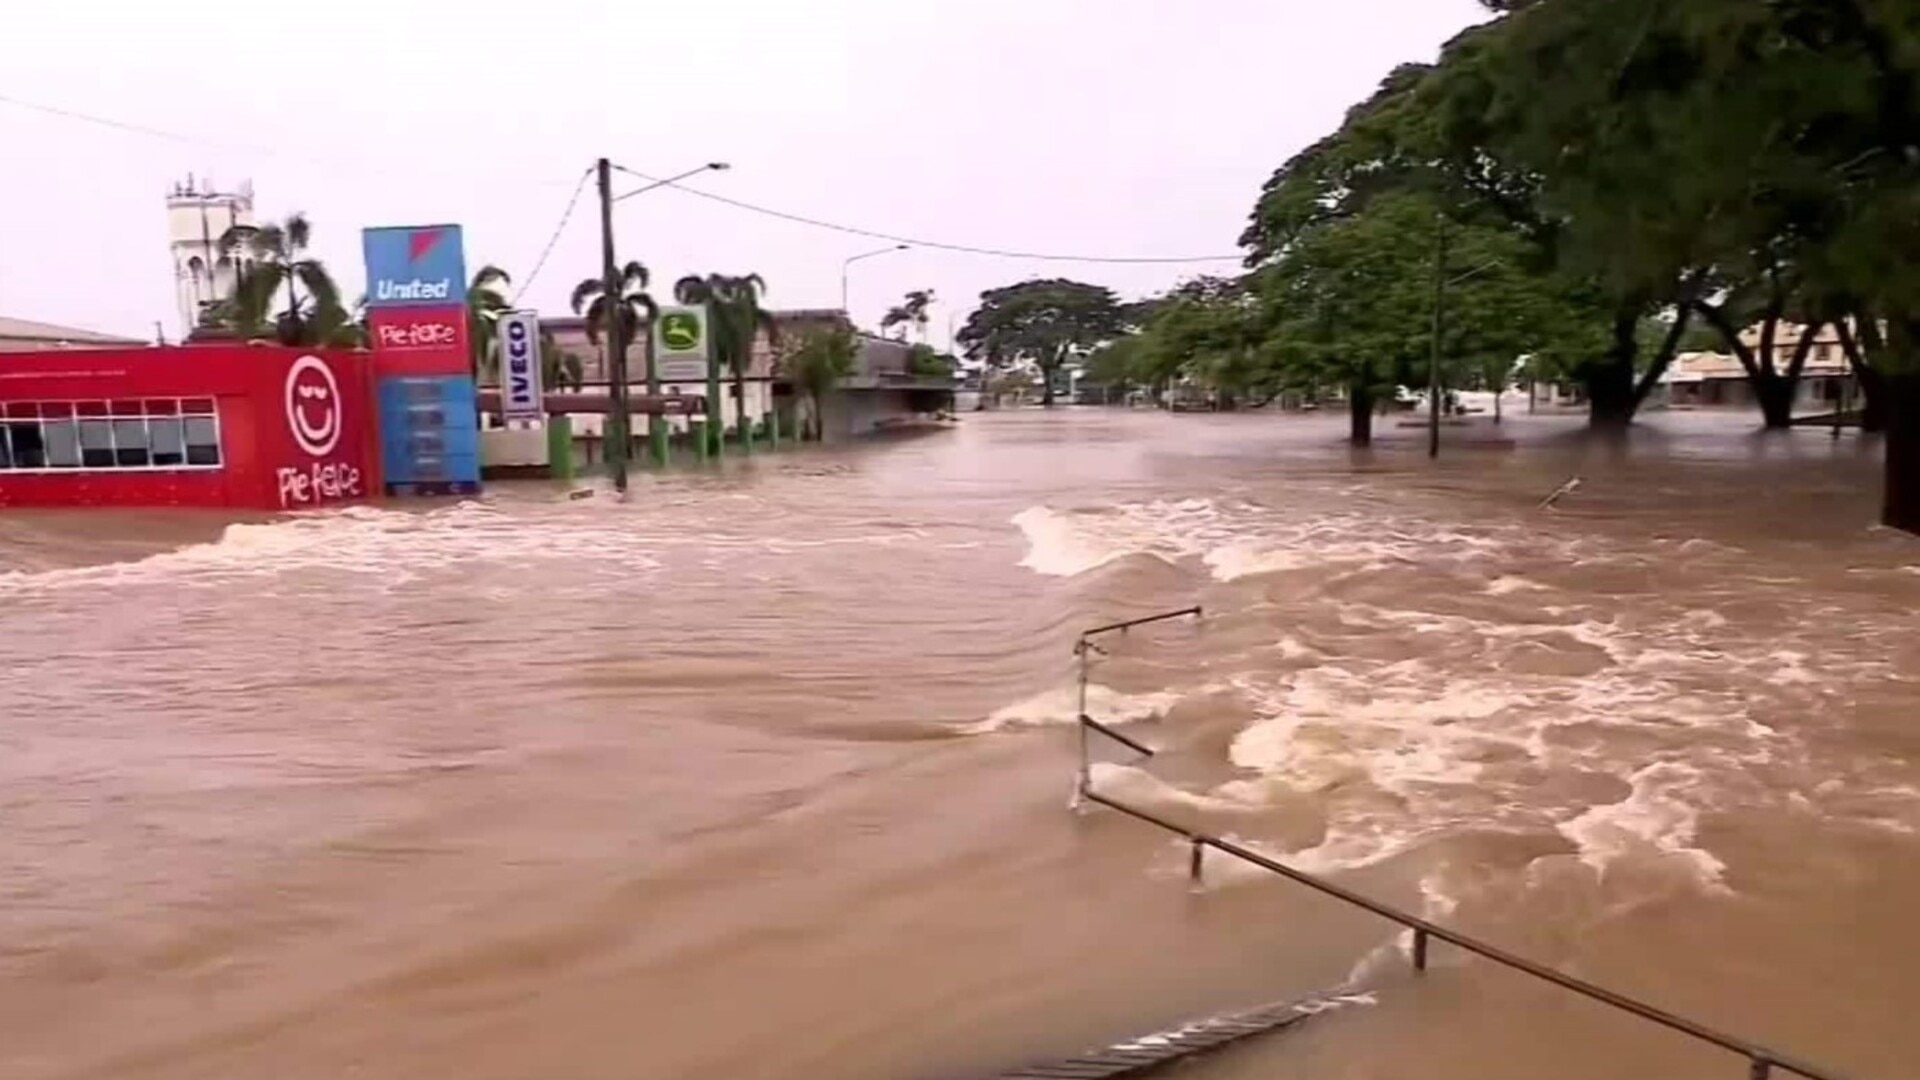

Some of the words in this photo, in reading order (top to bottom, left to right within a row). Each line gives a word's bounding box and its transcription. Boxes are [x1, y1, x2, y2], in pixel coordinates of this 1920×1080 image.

[377, 278, 450, 300] United
[379, 324, 407, 345] Pie
[508, 320, 530, 404] IVECO
[276, 466, 310, 508] Pie
